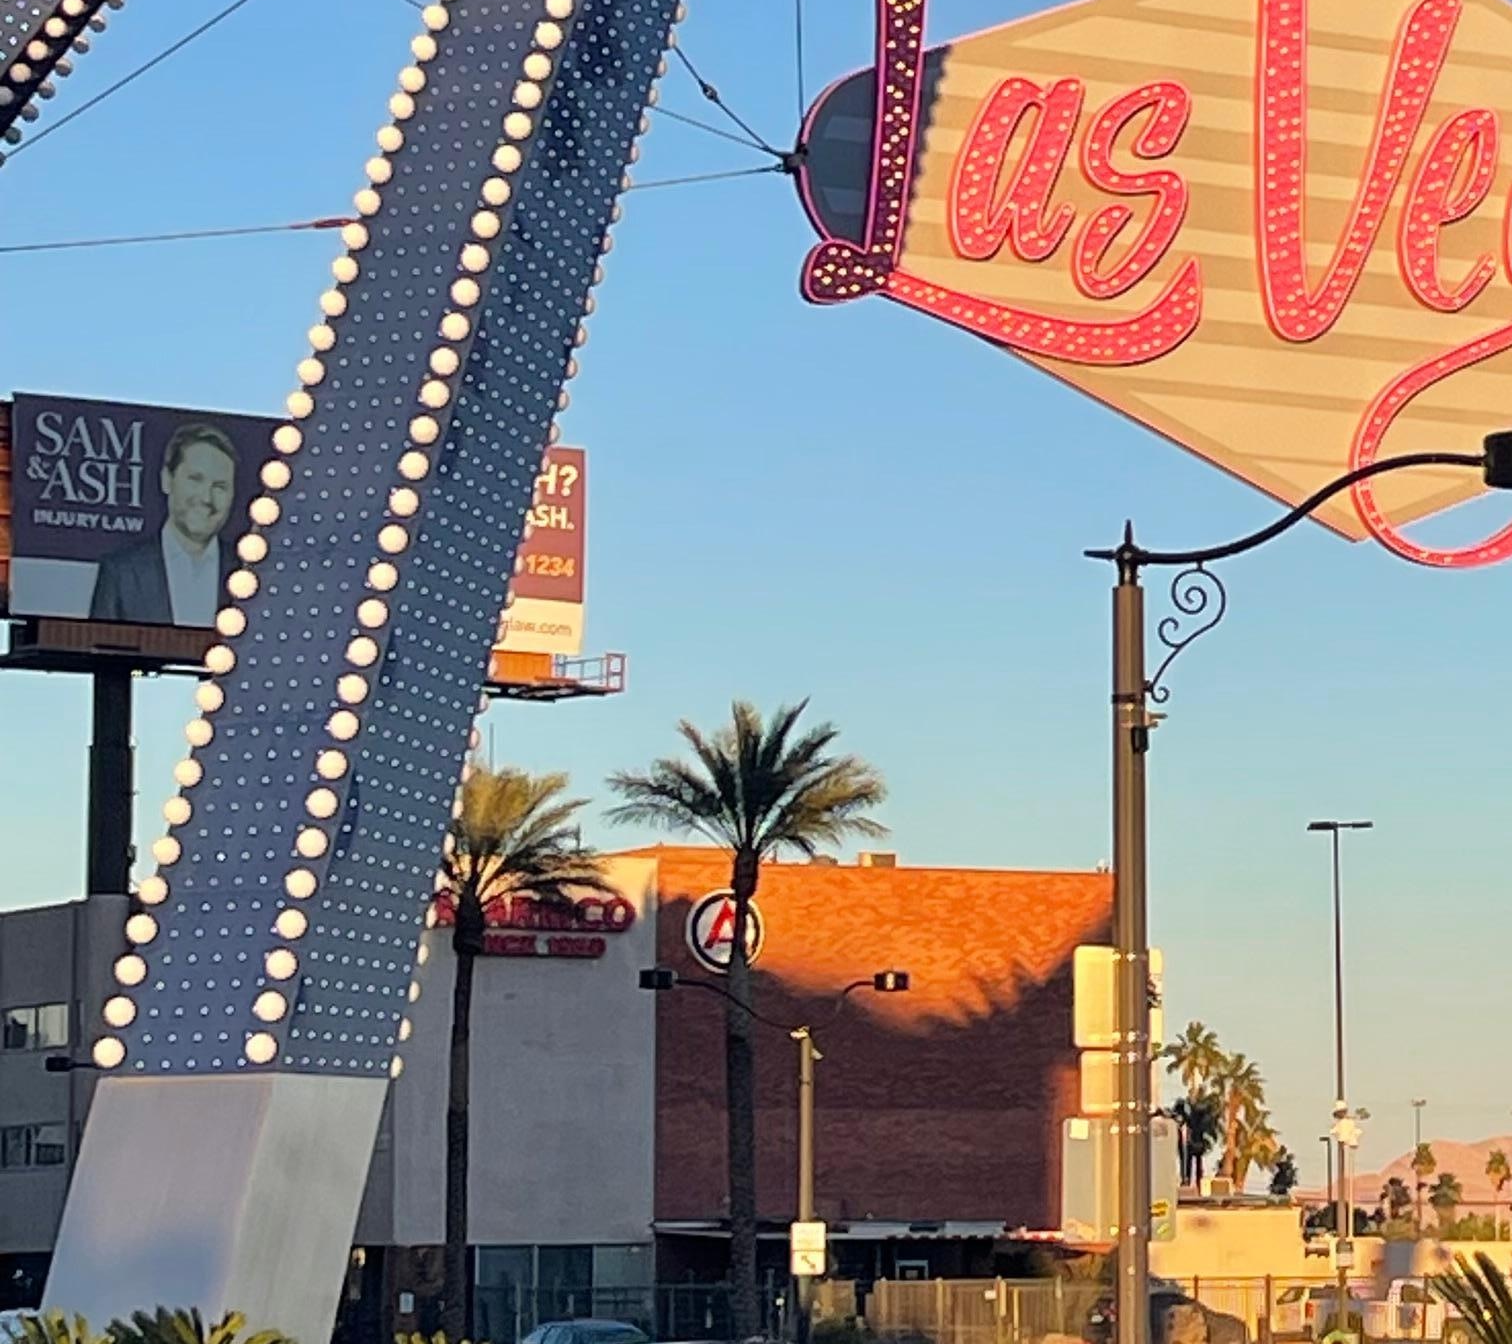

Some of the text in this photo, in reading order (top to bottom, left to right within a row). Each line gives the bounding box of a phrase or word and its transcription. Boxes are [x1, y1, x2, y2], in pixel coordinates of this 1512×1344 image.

[35, 411, 144, 463] SAM
[34, 508, 144, 532] INJURY LAW
